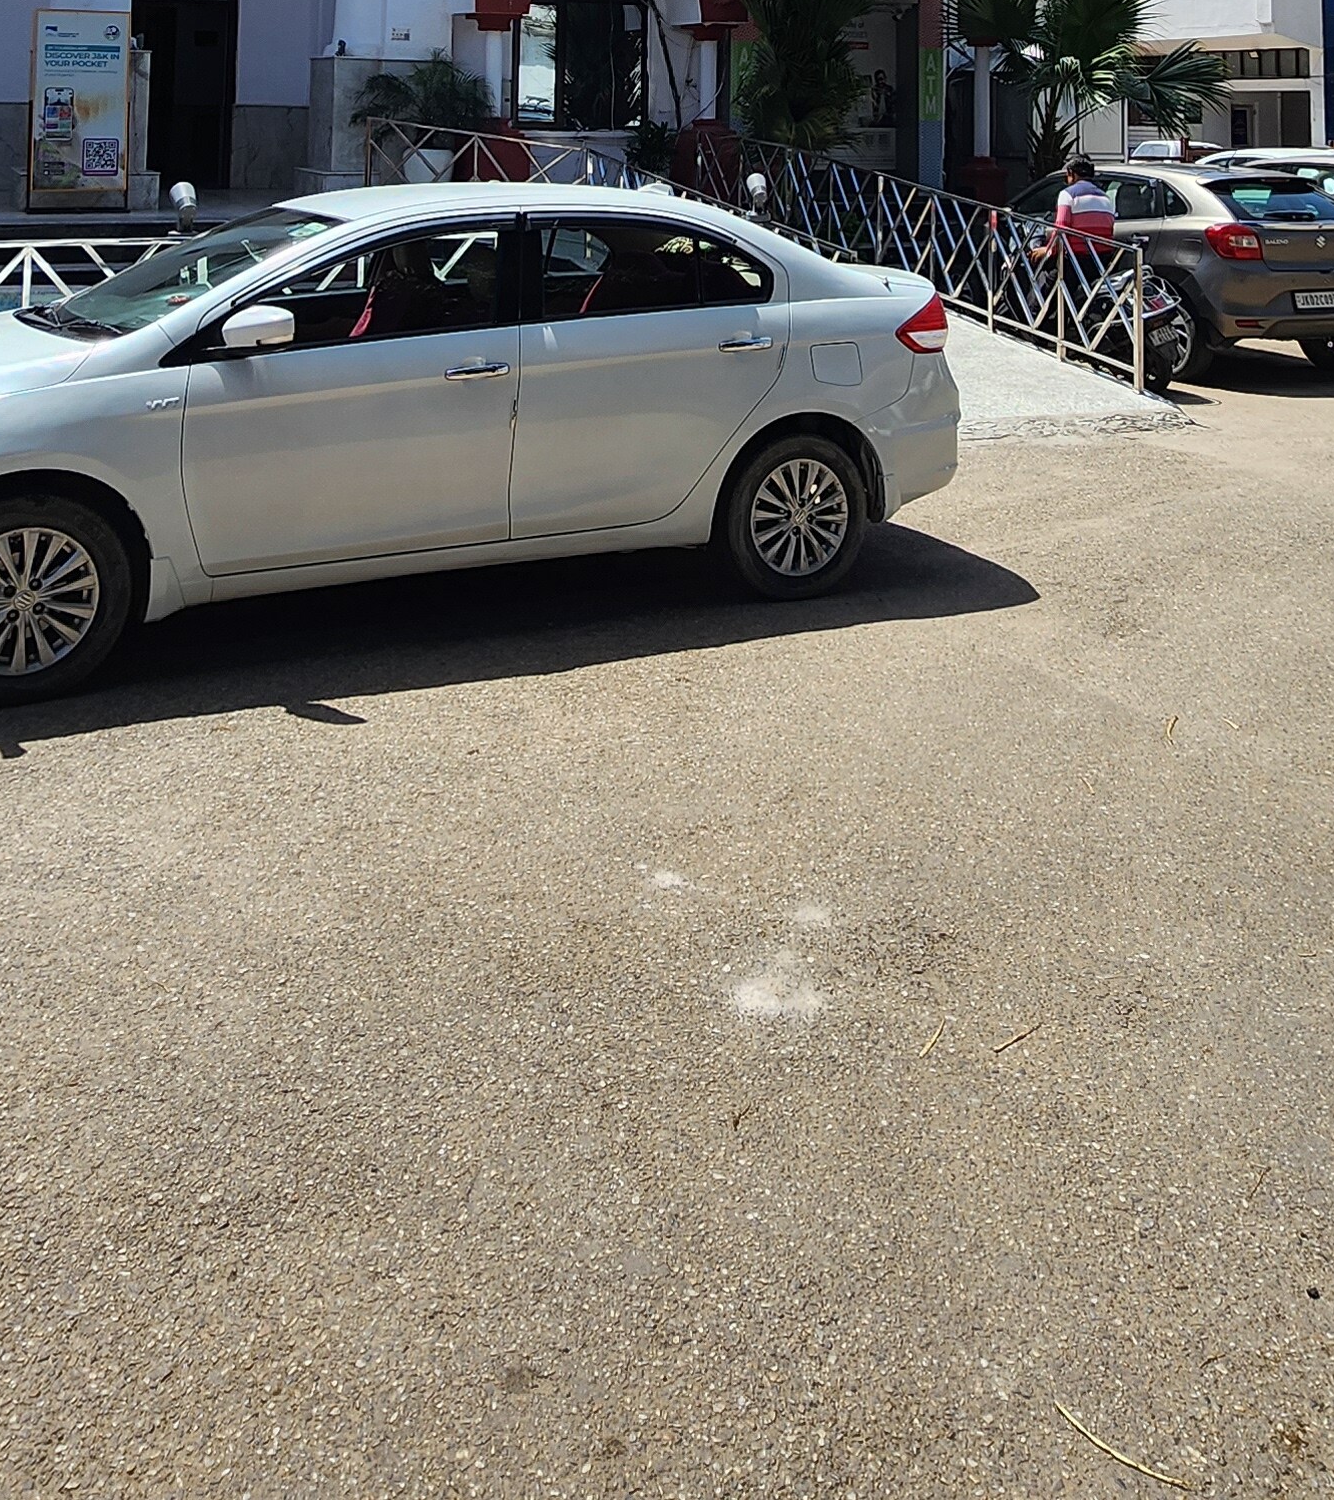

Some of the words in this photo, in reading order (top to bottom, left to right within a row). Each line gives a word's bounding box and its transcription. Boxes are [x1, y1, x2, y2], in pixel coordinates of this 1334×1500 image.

[44, 51, 90, 59] DISCOVER
[91, 52, 109, 60] J&K
[71, 60, 109, 68] POCKET
[924, 53, 938, 114] ATM
